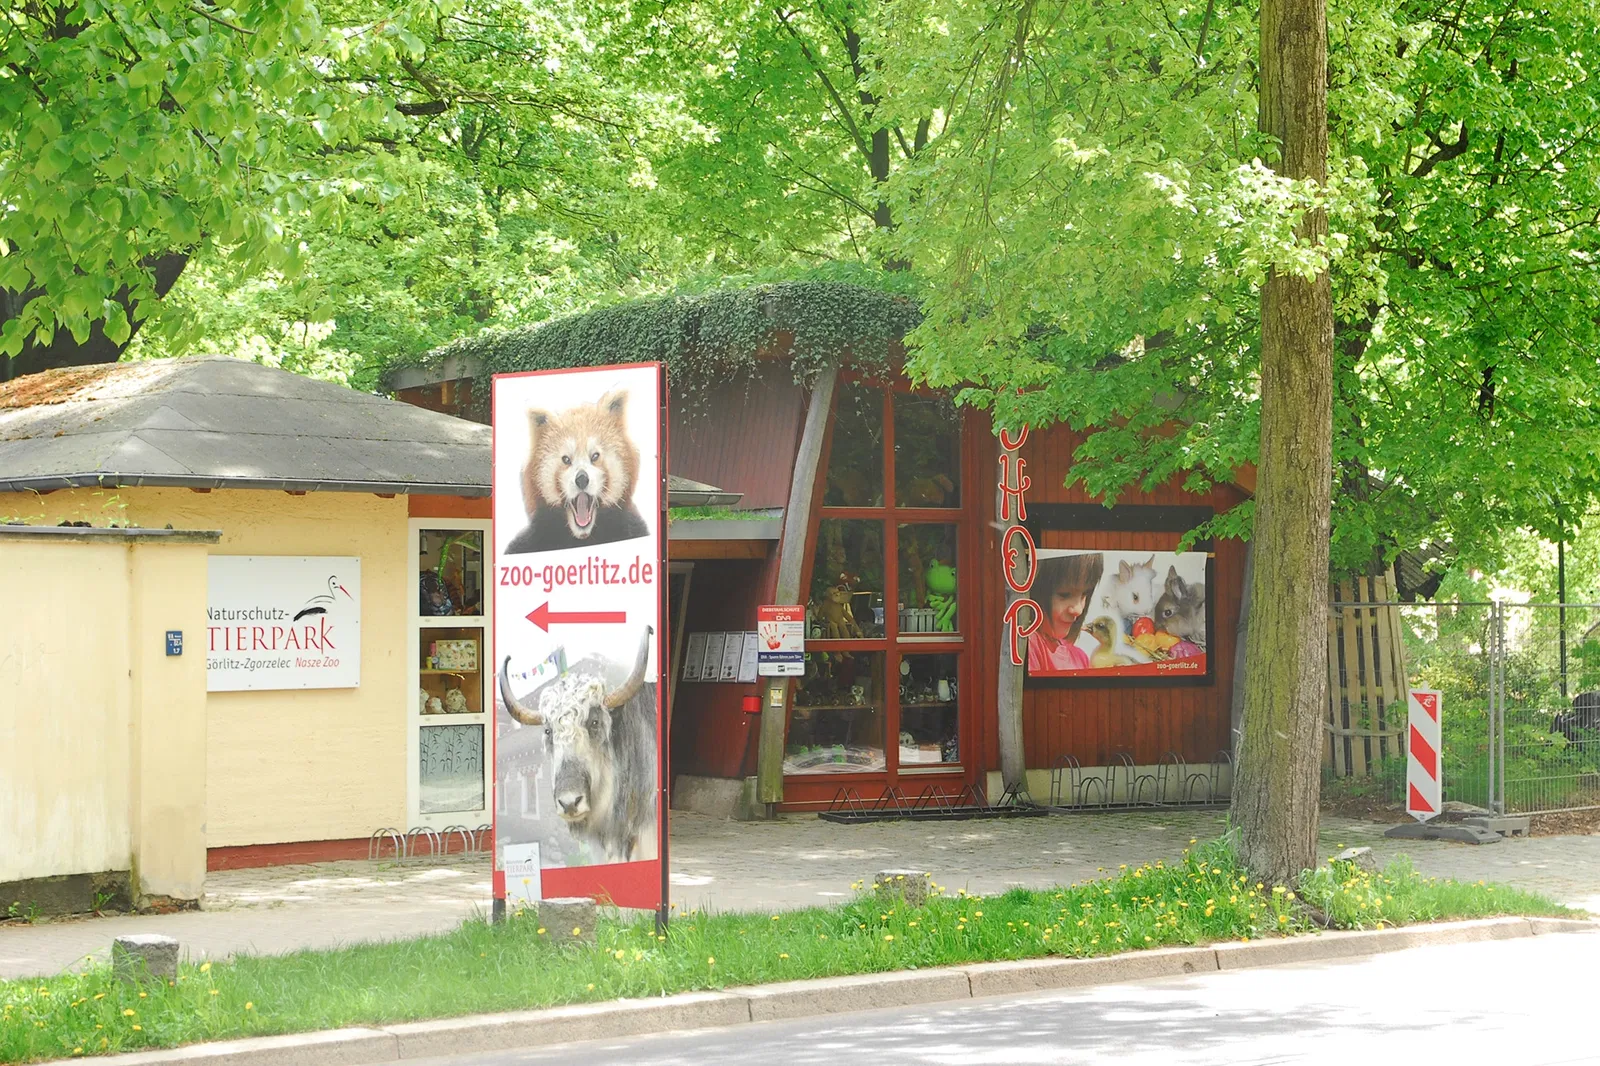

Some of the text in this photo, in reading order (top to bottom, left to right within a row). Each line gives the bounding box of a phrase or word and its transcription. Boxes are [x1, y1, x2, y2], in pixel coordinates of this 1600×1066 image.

[500, 555, 653, 593] zoo-goerlitz.de
[206, 606, 290, 620] Naturschutz-
[206, 616, 337, 655] TIERPARK
[206, 656, 340, 672] Görlitz-Zgorzelec Nasze Zoo
[1156, 662, 1199, 670] zoo-goerlitz.de
